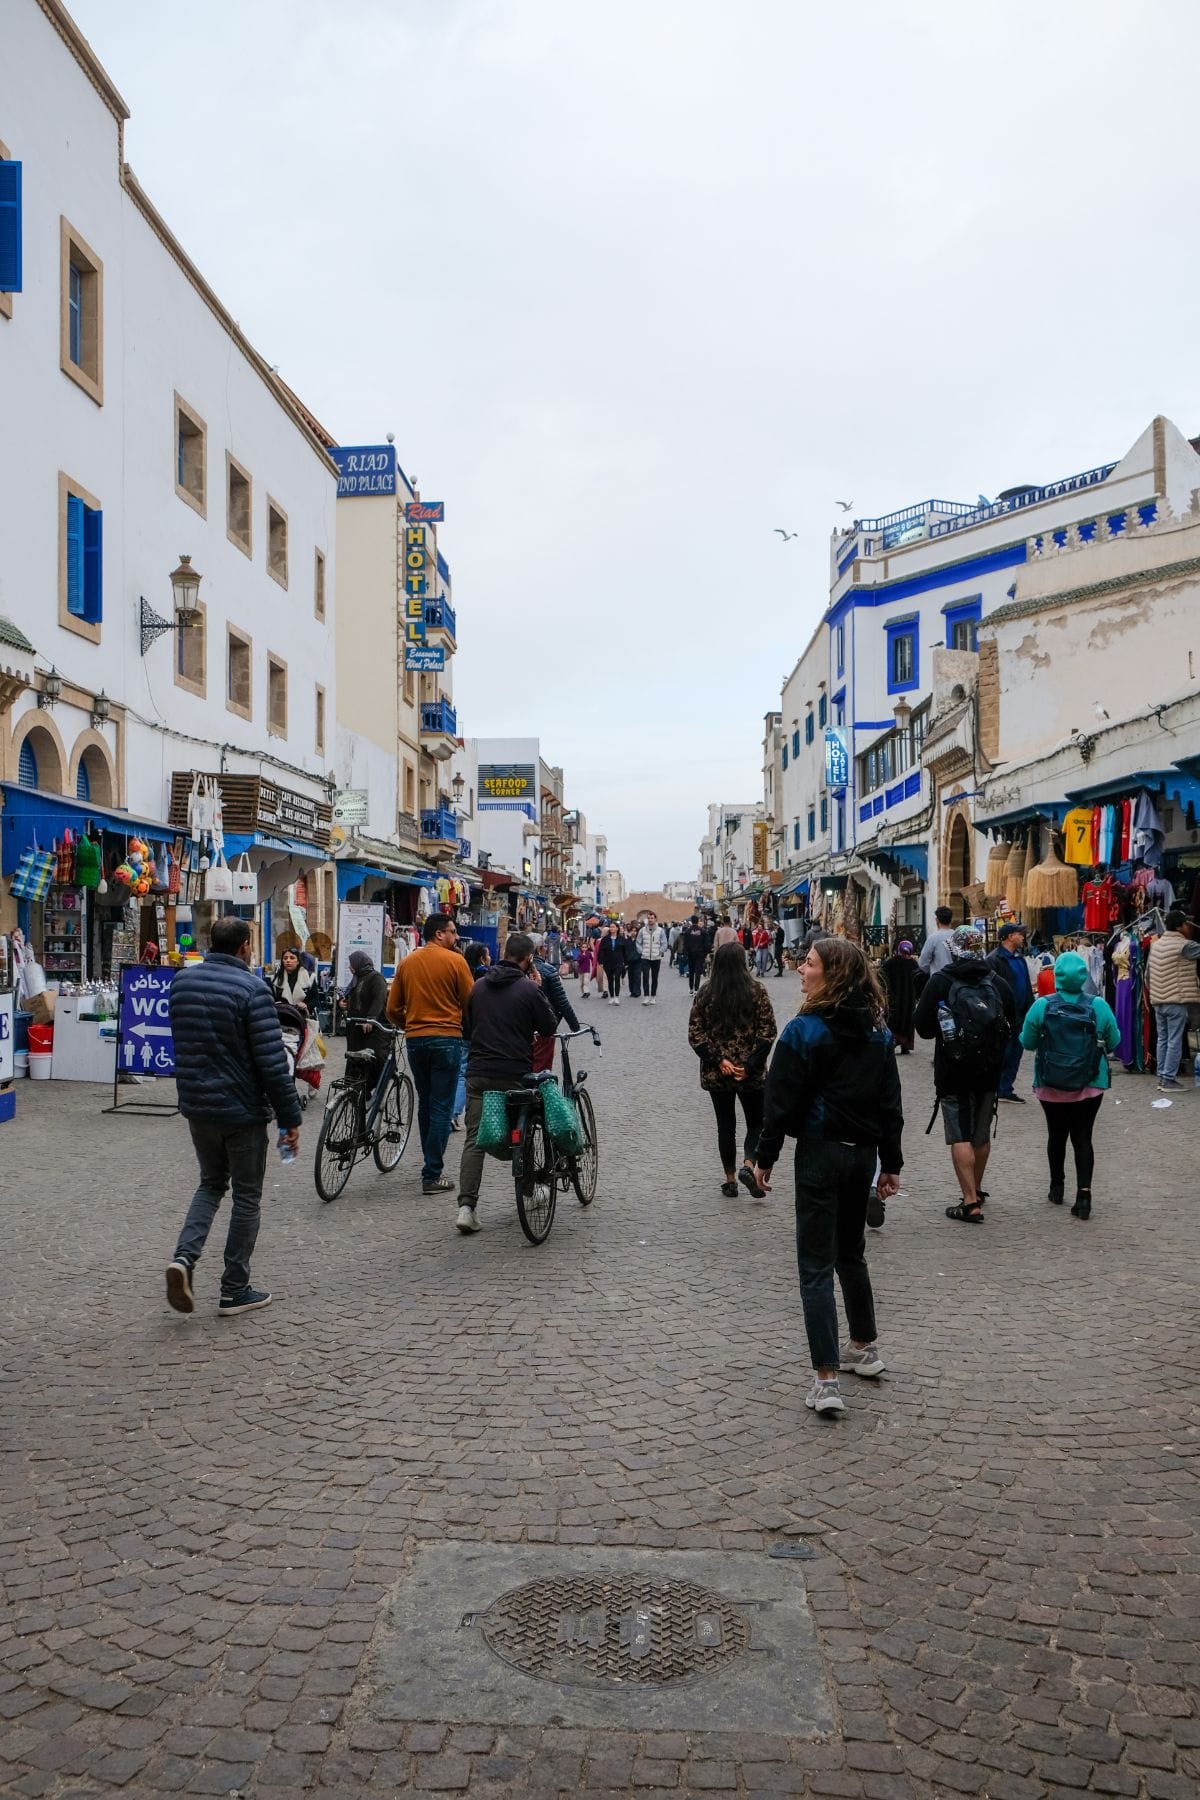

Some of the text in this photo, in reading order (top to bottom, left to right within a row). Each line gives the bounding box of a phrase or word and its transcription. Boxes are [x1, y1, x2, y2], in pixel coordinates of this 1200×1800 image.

[347, 453, 388, 472] RIAD
[358, 474, 394, 491] PALACE
[408, 503, 443, 520] Riad
[407, 528, 424, 640] HOTEL
[831, 740, 840, 784] HOTEL
[484, 778, 528, 788] SEAFOOD
[260, 787, 276, 802] PETIT
[490, 788, 521, 796] CORNER
[1077, 826, 1086, 843] 7
[131, 997, 169, 1018] WC
